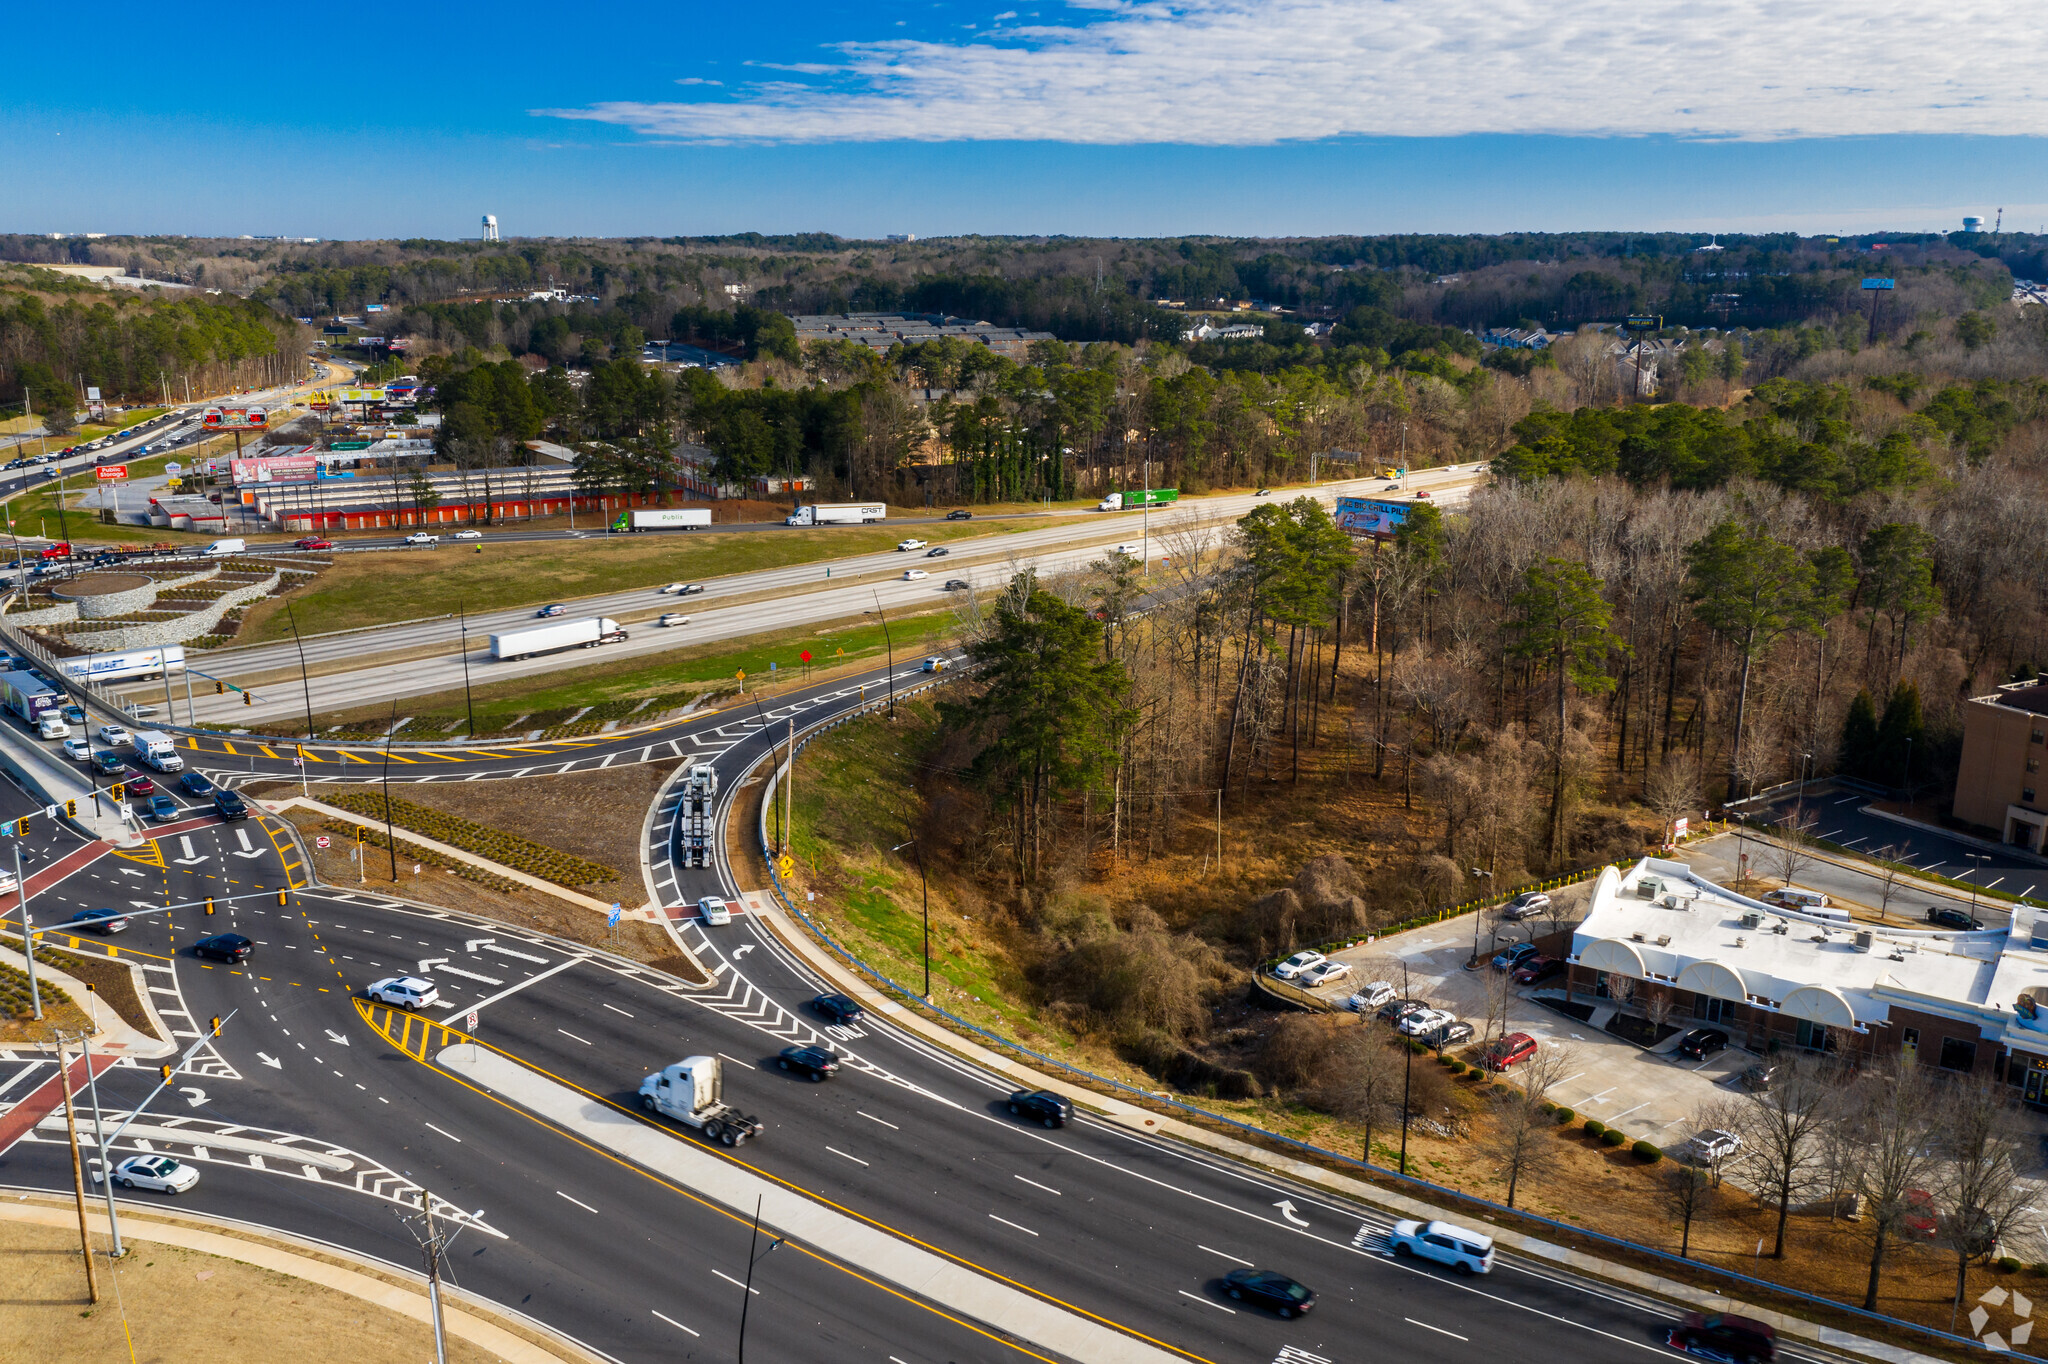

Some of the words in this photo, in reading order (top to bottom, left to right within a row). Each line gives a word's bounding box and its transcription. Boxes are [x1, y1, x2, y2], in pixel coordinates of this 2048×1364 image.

[1354, 502, 1367, 510] BIG
[1368, 504, 1389, 514] CHILL
[824, 1022, 868, 1042] ONLY
